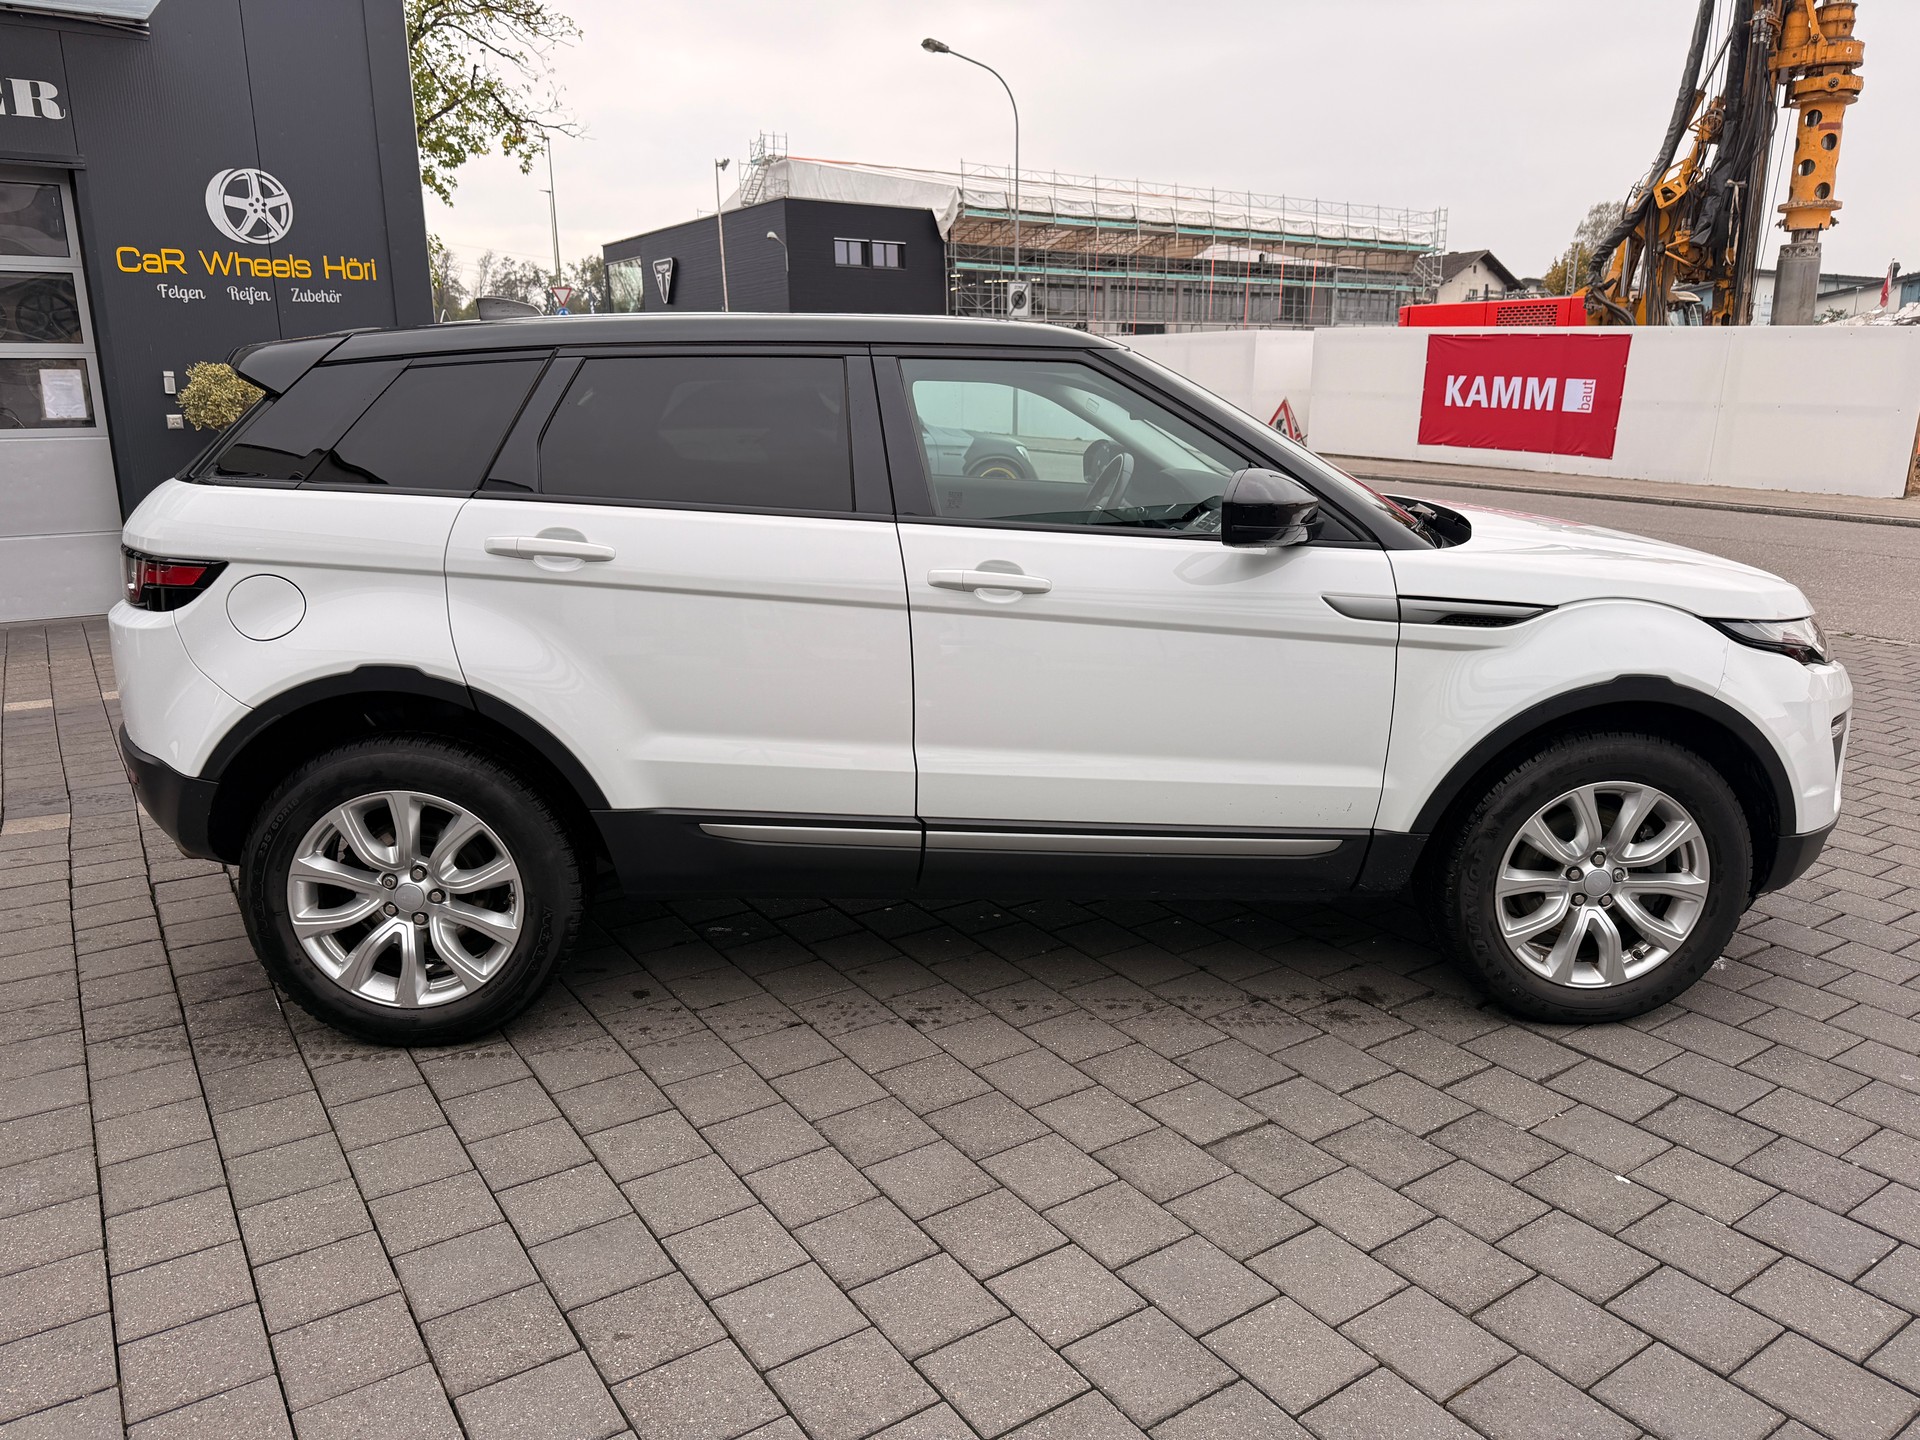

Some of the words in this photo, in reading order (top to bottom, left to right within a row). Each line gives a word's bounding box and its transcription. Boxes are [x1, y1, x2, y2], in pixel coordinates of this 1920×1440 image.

[0, 77, 66, 120] R
[115, 246, 188, 275] CaR
[198, 249, 312, 279] Wheels
[322, 254, 377, 281] Höri
[157, 283, 206, 303] Felgen
[226, 285, 271, 304] Reifen
[290, 287, 342, 303] Zubehör
[1444, 374, 1558, 411] KAMM
[1577, 380, 1595, 411] baut
